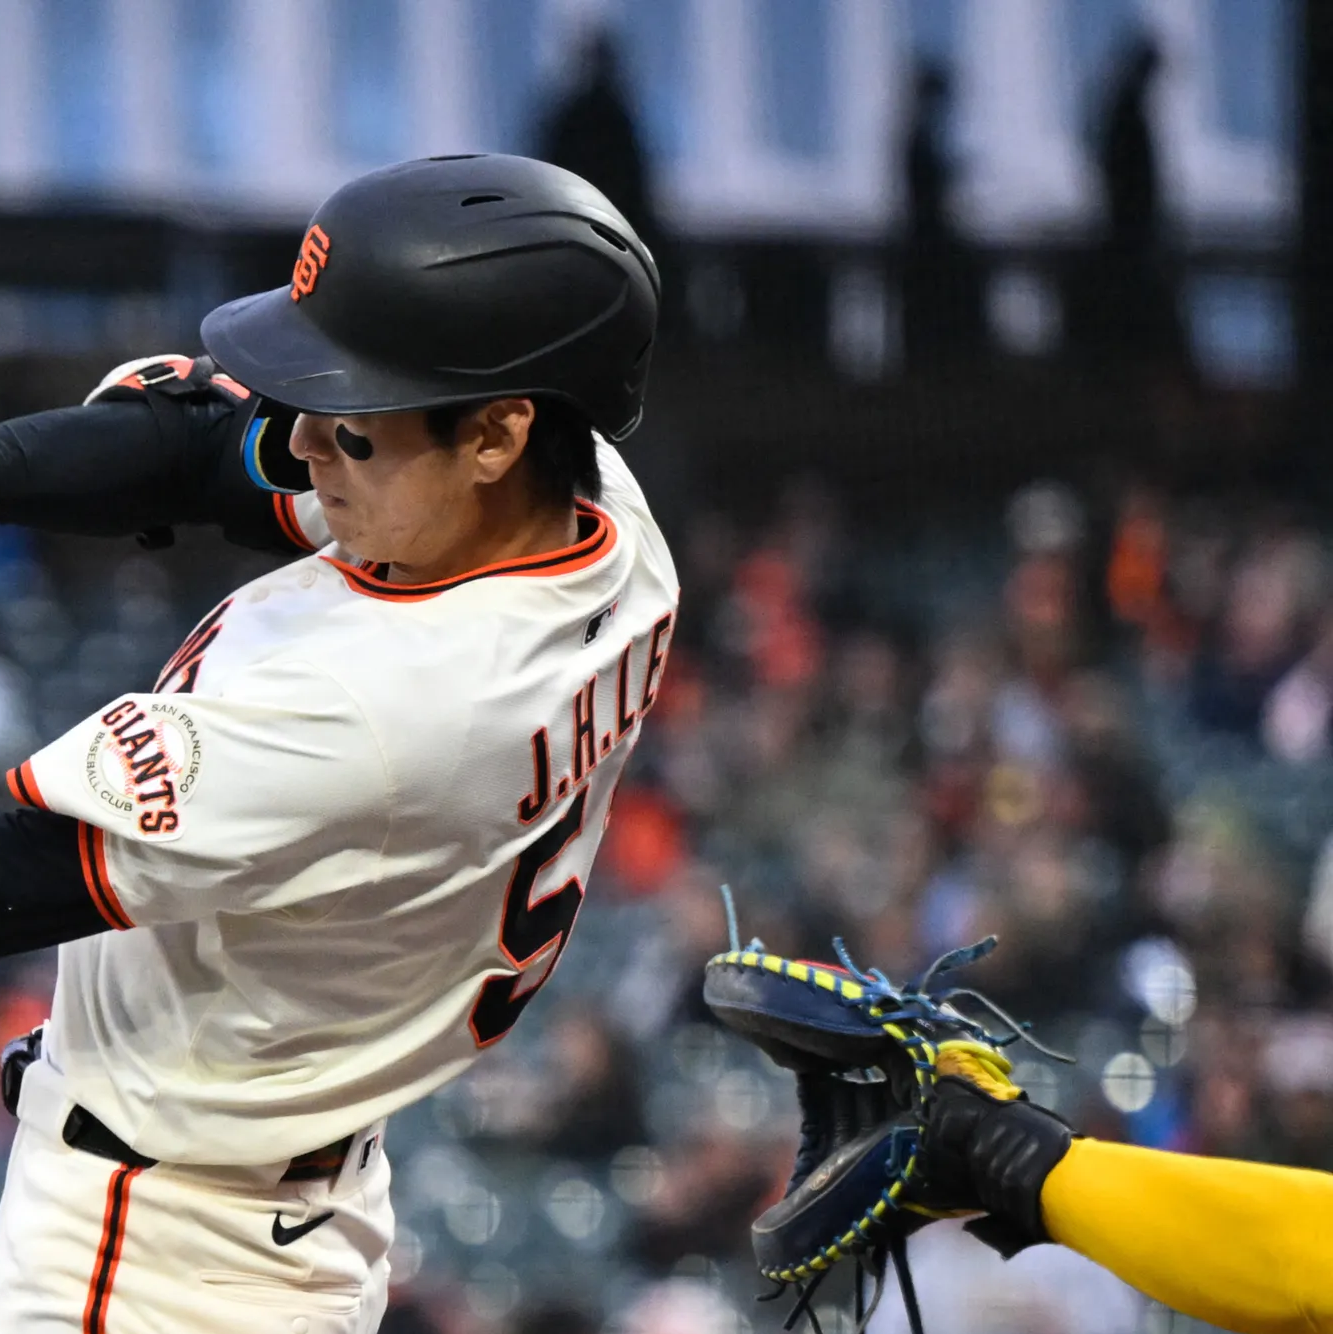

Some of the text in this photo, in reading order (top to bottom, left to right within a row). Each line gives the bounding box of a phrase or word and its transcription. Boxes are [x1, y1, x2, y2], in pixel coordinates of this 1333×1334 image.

[86, 731, 133, 812] BASEBALL CLUB
[101, 700, 179, 835] GIANTS
[151, 704, 201, 793] SAN FRANCISCO
